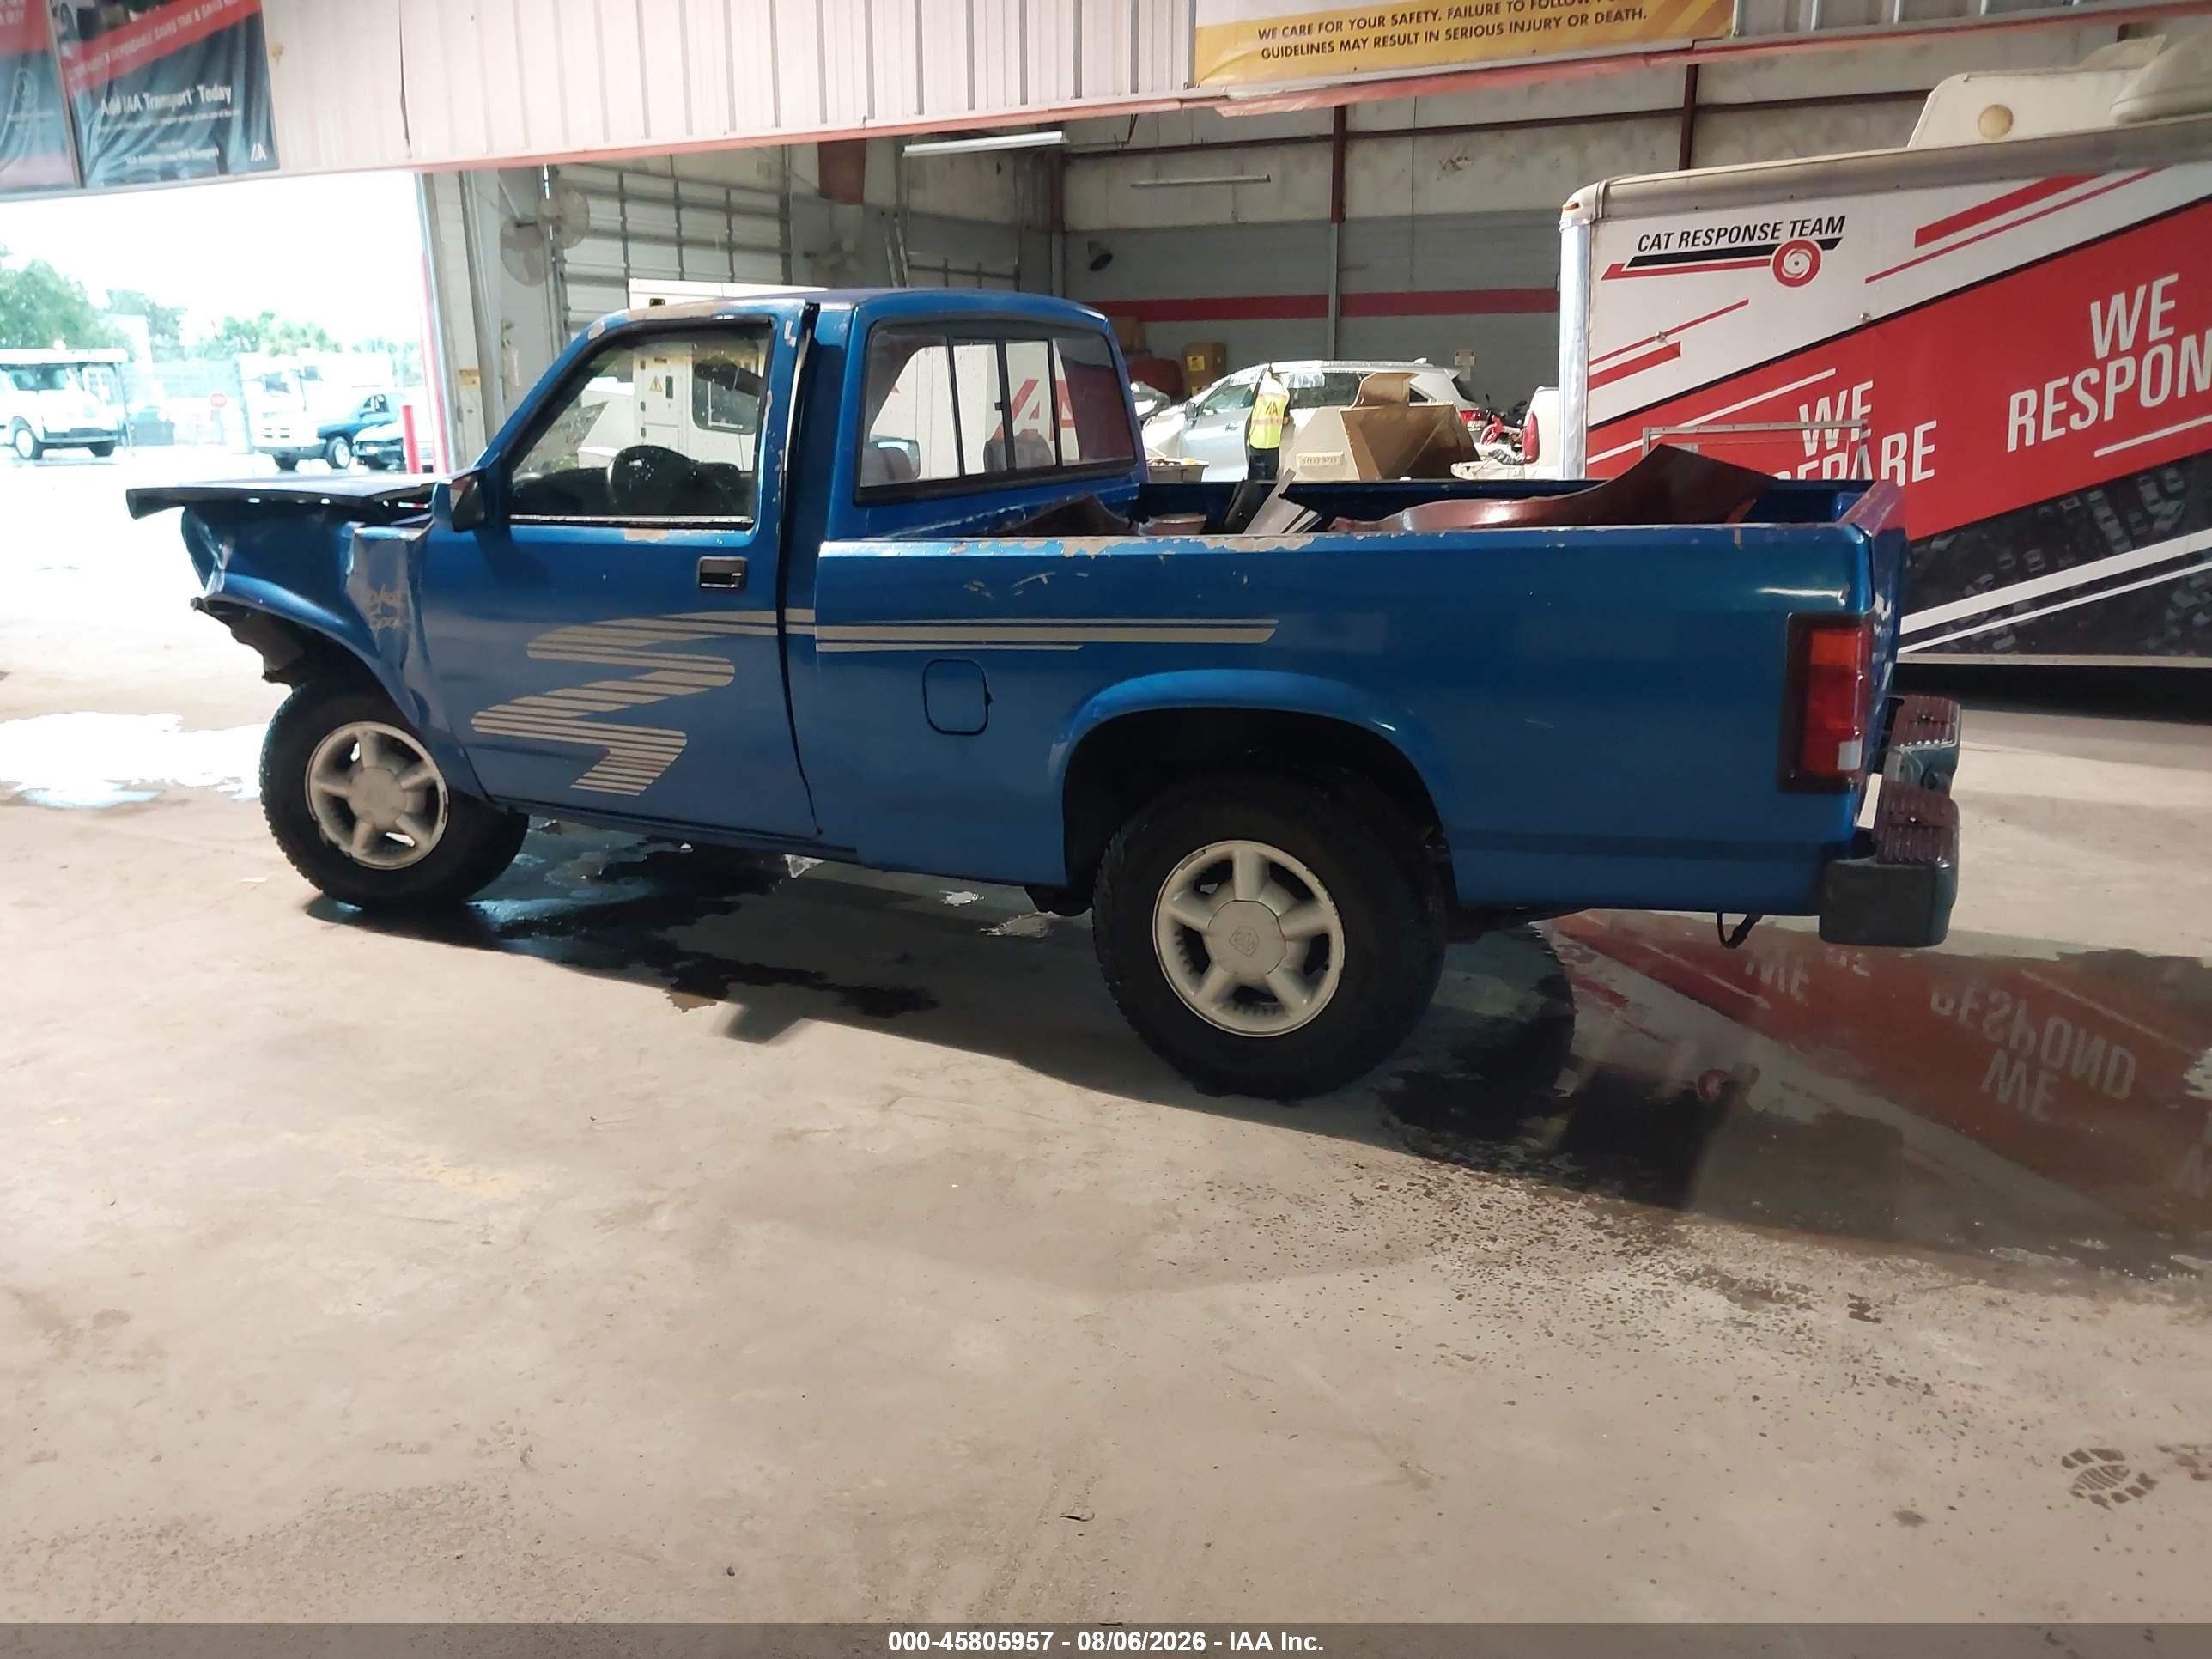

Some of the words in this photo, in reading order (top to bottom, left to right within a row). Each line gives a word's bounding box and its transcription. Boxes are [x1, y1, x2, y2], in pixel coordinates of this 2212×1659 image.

[1258, 27, 1278, 40] WE
[1282, 22, 1314, 38] CARE
[1318, 20, 1343, 36] FOR
[1348, 14, 1386, 31] YOUR
[1390, 9, 1442, 27] SAFETY.
[1448, 2, 1501, 20] FAILURE
[1505, 0, 1525, 13] TO
[1261, 41, 1334, 60] GUIDELINES
[1339, 37, 1368, 52] MAY
[1373, 32, 1419, 49] RESULT
[1425, 30, 1439, 43] IN
[1444, 21, 1504, 41] SERIOUS
[1509, 15, 1562, 33] INJURY
[1567, 13, 1589, 27] OR
[1595, 7, 1647, 25] DEATH.
[100, 96, 122, 117] Add
[197, 83, 232, 105] Today
[1638, 232, 1674, 252] CAT
[1678, 221, 1784, 249] RESPONSE
[1789, 215, 1846, 239] TEAM
[2090, 272, 2179, 360] WE
[1799, 380, 1875, 458] WE
